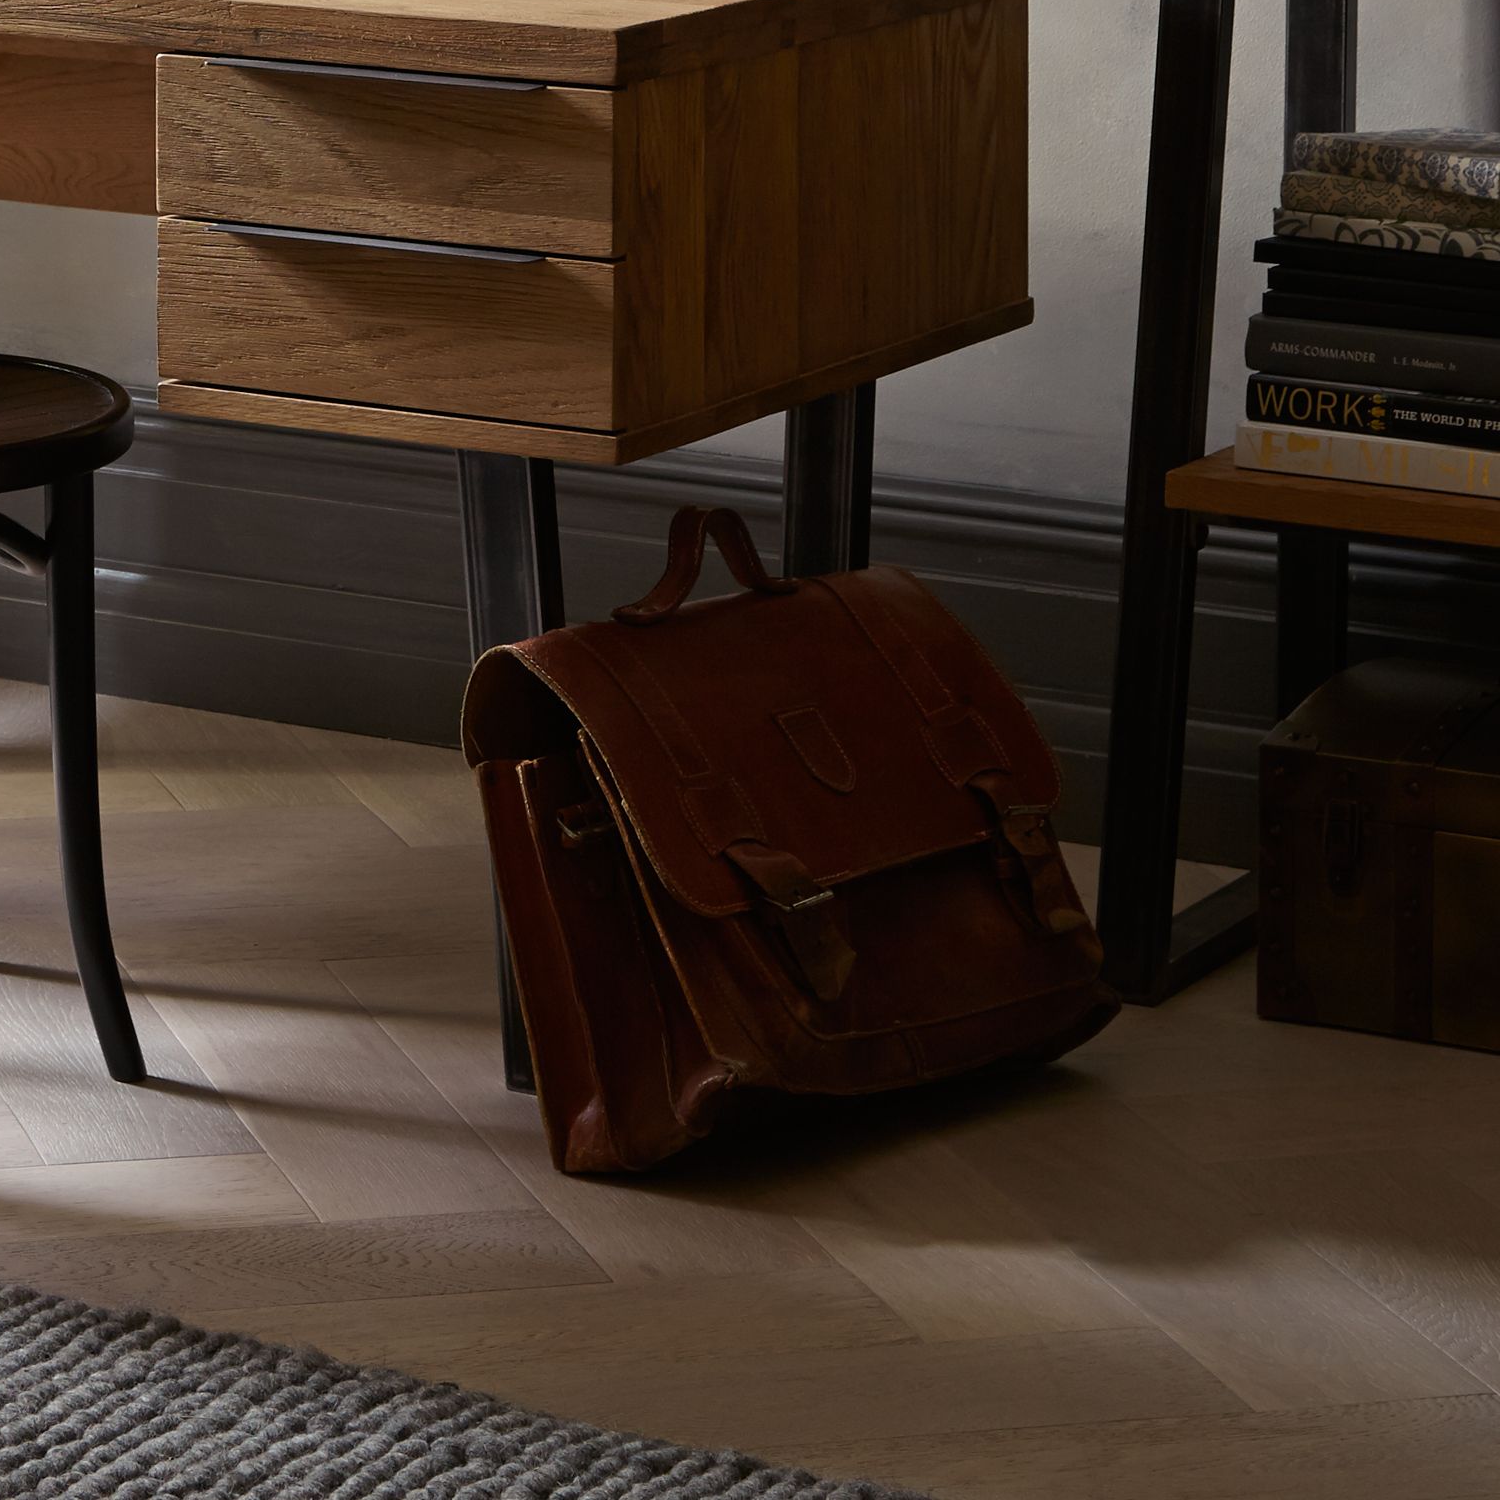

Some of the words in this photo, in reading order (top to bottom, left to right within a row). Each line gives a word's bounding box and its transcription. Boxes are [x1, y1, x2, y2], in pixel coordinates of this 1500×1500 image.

[1270, 341, 1376, 364] ARMS-COMMANDER
[1256, 382, 1366, 428] WORK
[1393, 408, 1418, 422] THE
[1420, 411, 1465, 428] WORLD
[1467, 418, 1482, 429] IN
